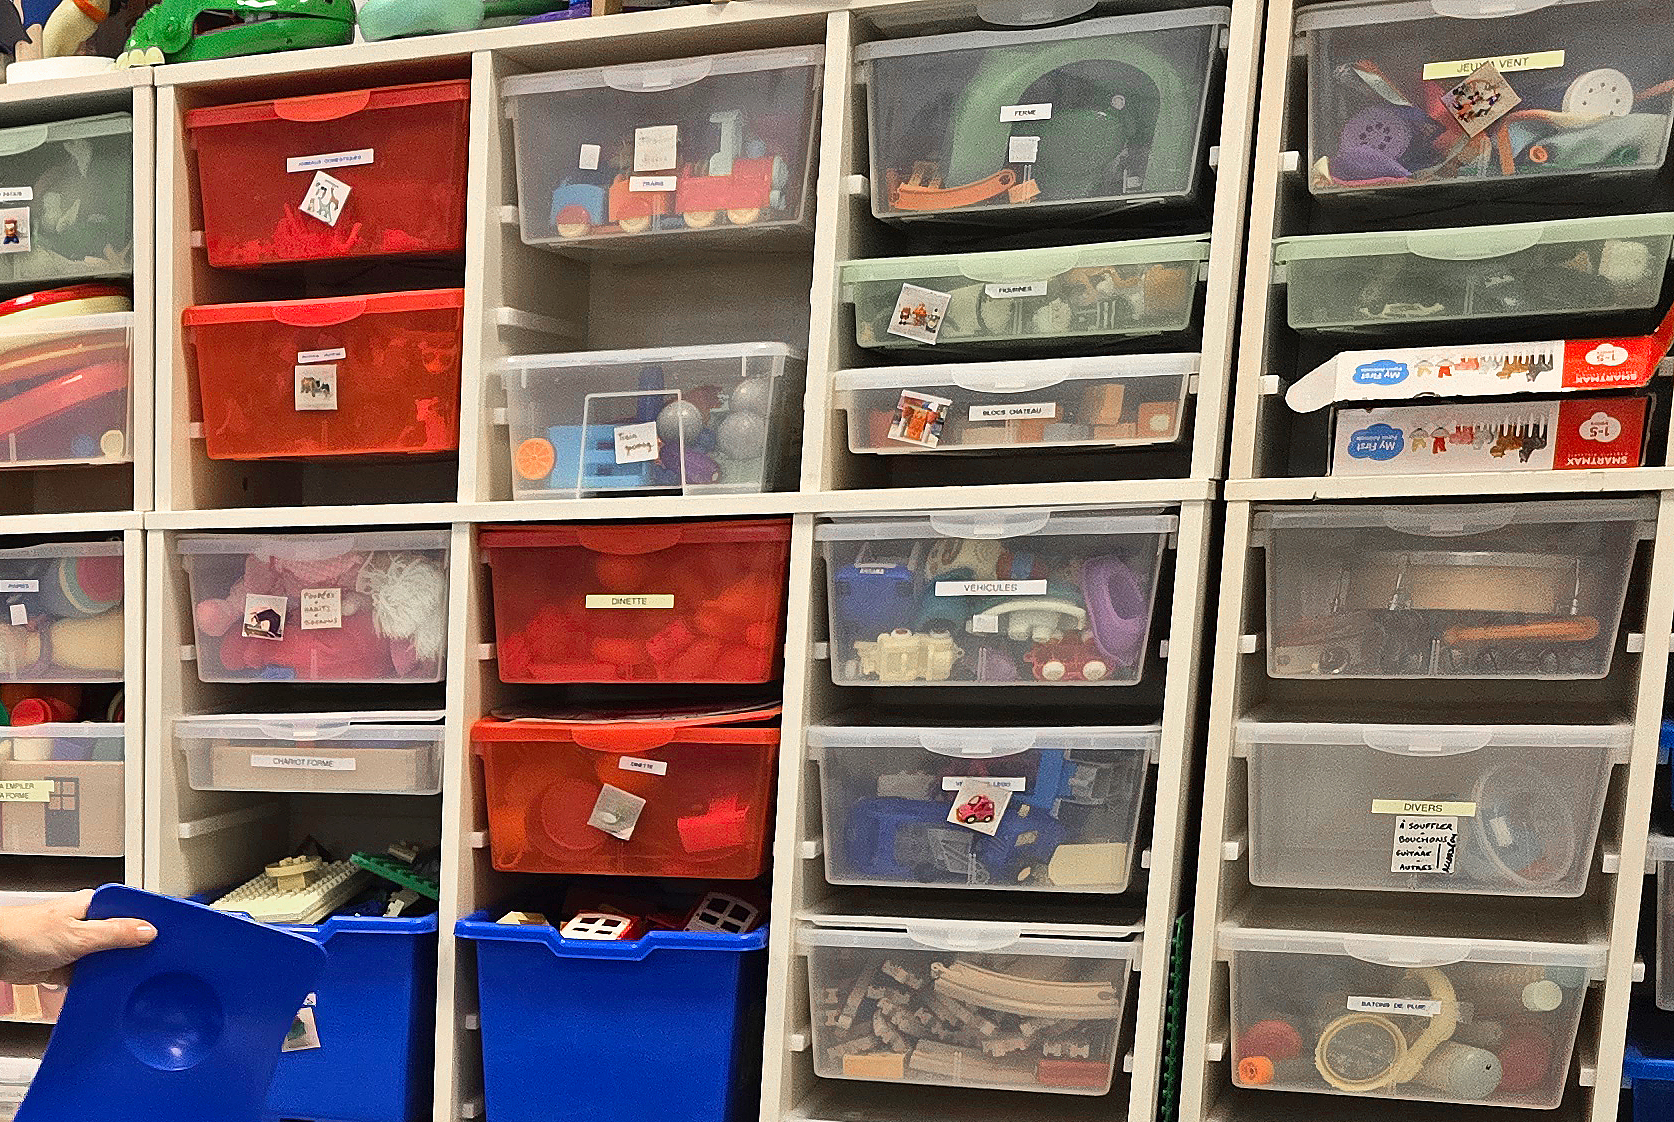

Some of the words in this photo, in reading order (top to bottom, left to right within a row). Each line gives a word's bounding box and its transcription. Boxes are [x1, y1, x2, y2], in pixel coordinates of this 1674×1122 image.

[1499, 57, 1529, 68] VENT
[1015, 109, 1036, 117] FERME
[1590, 425, 1610, 437] 1-5
[1357, 442, 1377, 452] First
[1379, 442, 1395, 452] My
[1567, 456, 1628, 465] SMARTMAX
[611, 597, 647, 605] DINETTE
[273, 758, 303, 766] CHARIOT
[306, 759, 334, 767] FORME
[1404, 803, 1442, 813] DIVERS
[1408, 823, 1453, 831] SOUFFLER
[1398, 836, 1447, 844] BOUCHONS
